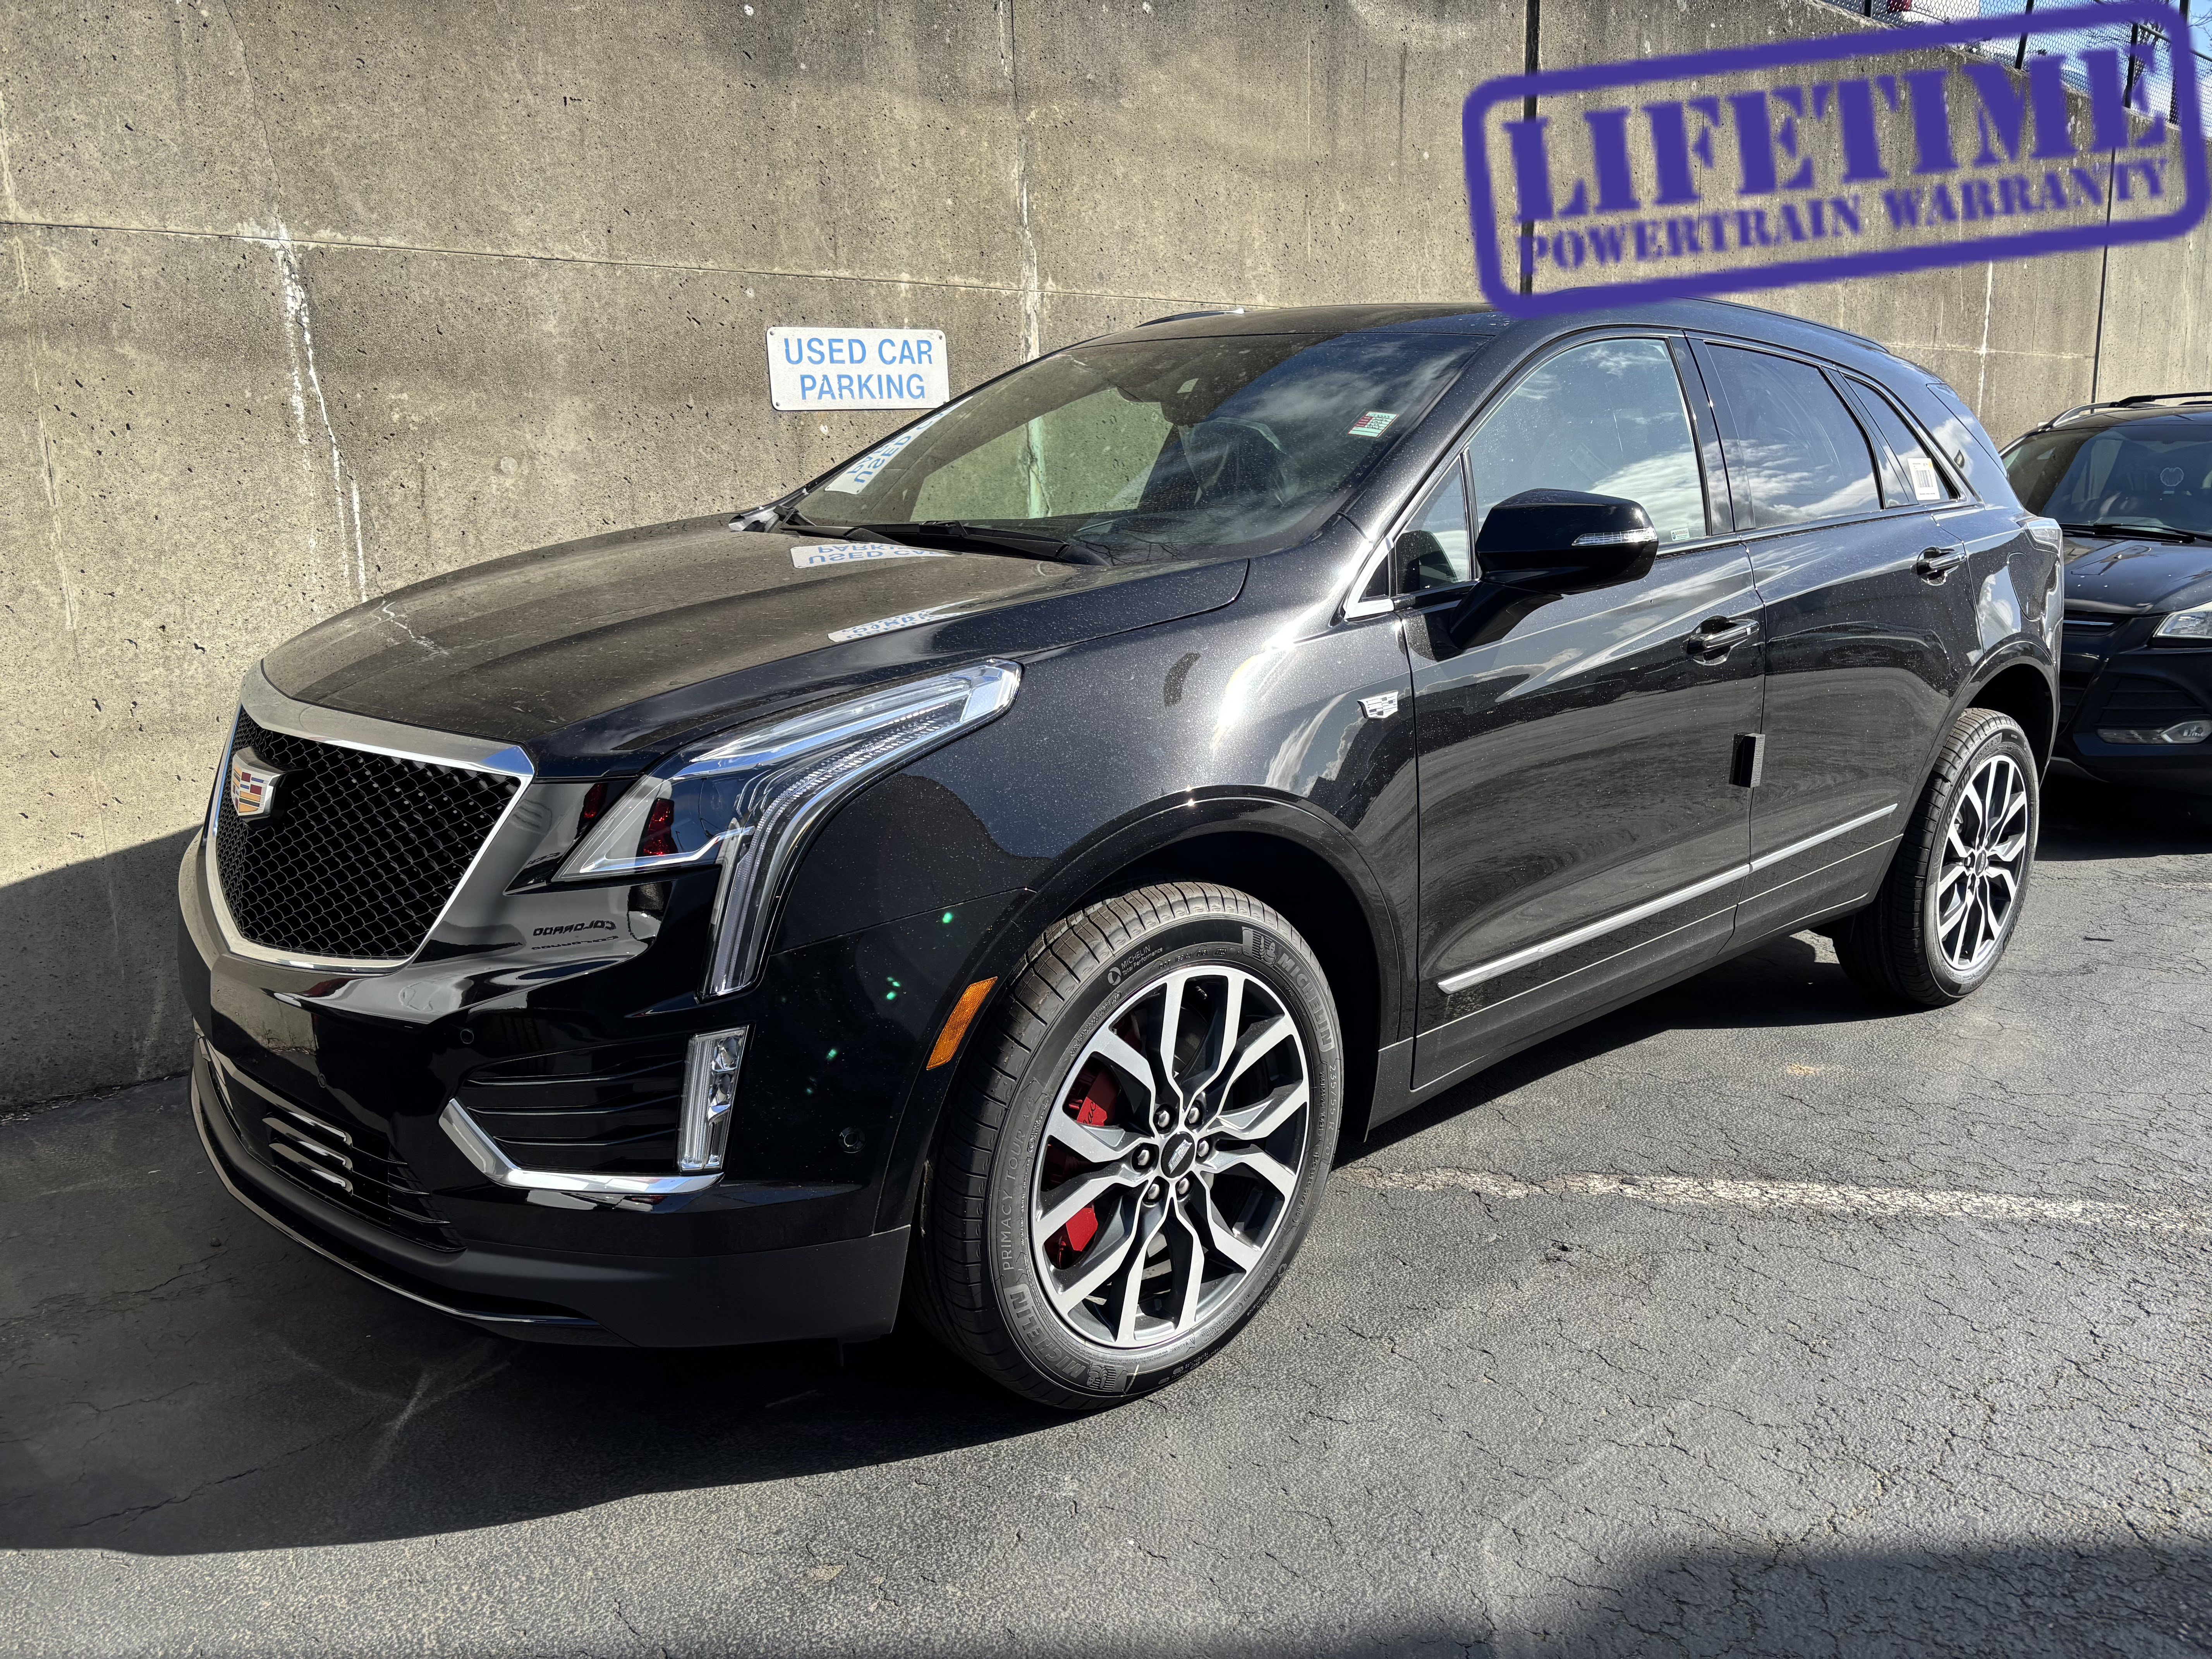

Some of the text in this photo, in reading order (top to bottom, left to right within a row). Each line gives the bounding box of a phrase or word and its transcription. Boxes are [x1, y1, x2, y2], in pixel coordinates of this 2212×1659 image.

[784, 337, 933, 365] USED CAR
[800, 373, 925, 400] PARKING
[1121, 944, 1151, 968] MICHELIN
[1122, 965, 1133, 976] Total
[1133, 947, 1163, 969] Performance
[1277, 953, 1332, 1046] MICHELIN
[1328, 1121, 1335, 1130] R
[1005, 1129, 1026, 1181] TOUR
[1325, 1137, 1332, 1156] 20
[1000, 1188, 1015, 1271] PRIMACY
[1010, 1291, 1086, 1379] MICHELIN
